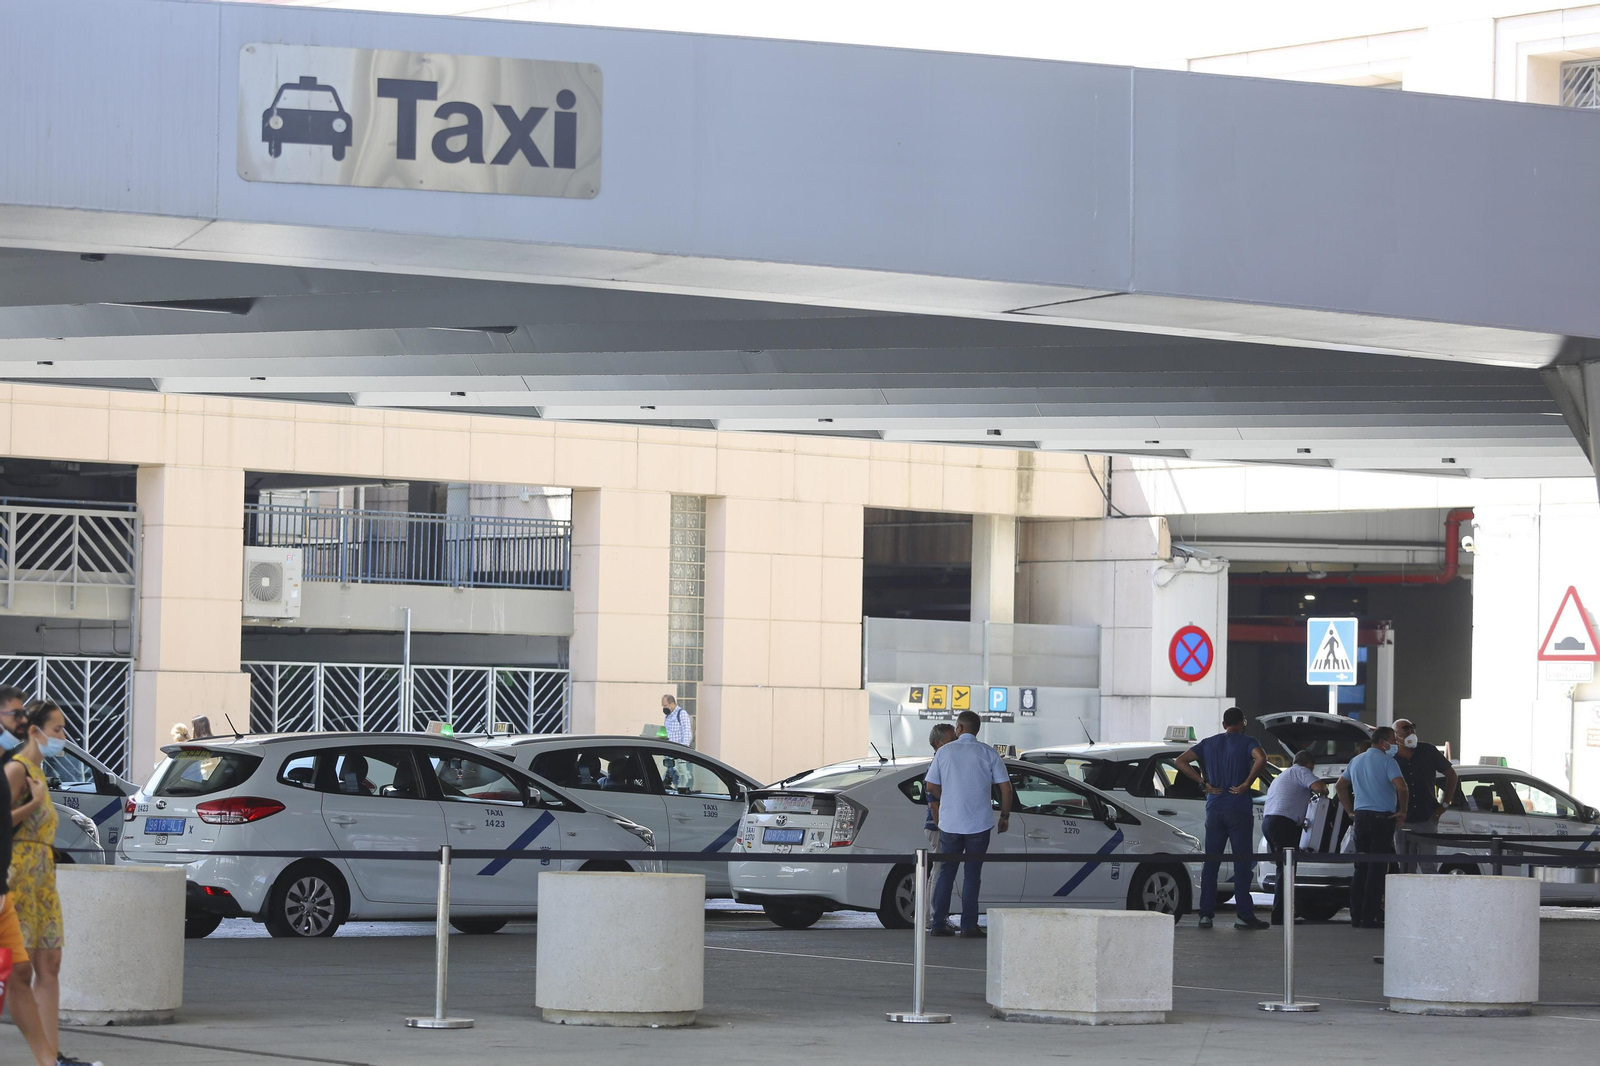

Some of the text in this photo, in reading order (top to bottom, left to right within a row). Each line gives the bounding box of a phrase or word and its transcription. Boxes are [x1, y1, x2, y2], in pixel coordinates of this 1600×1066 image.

[377, 78, 577, 169] Taxi
[993, 690, 1004, 709] P
[485, 809, 504, 817] TAXI
[485, 819, 506, 828] 1423
[1063, 827, 1080, 835] 1270
